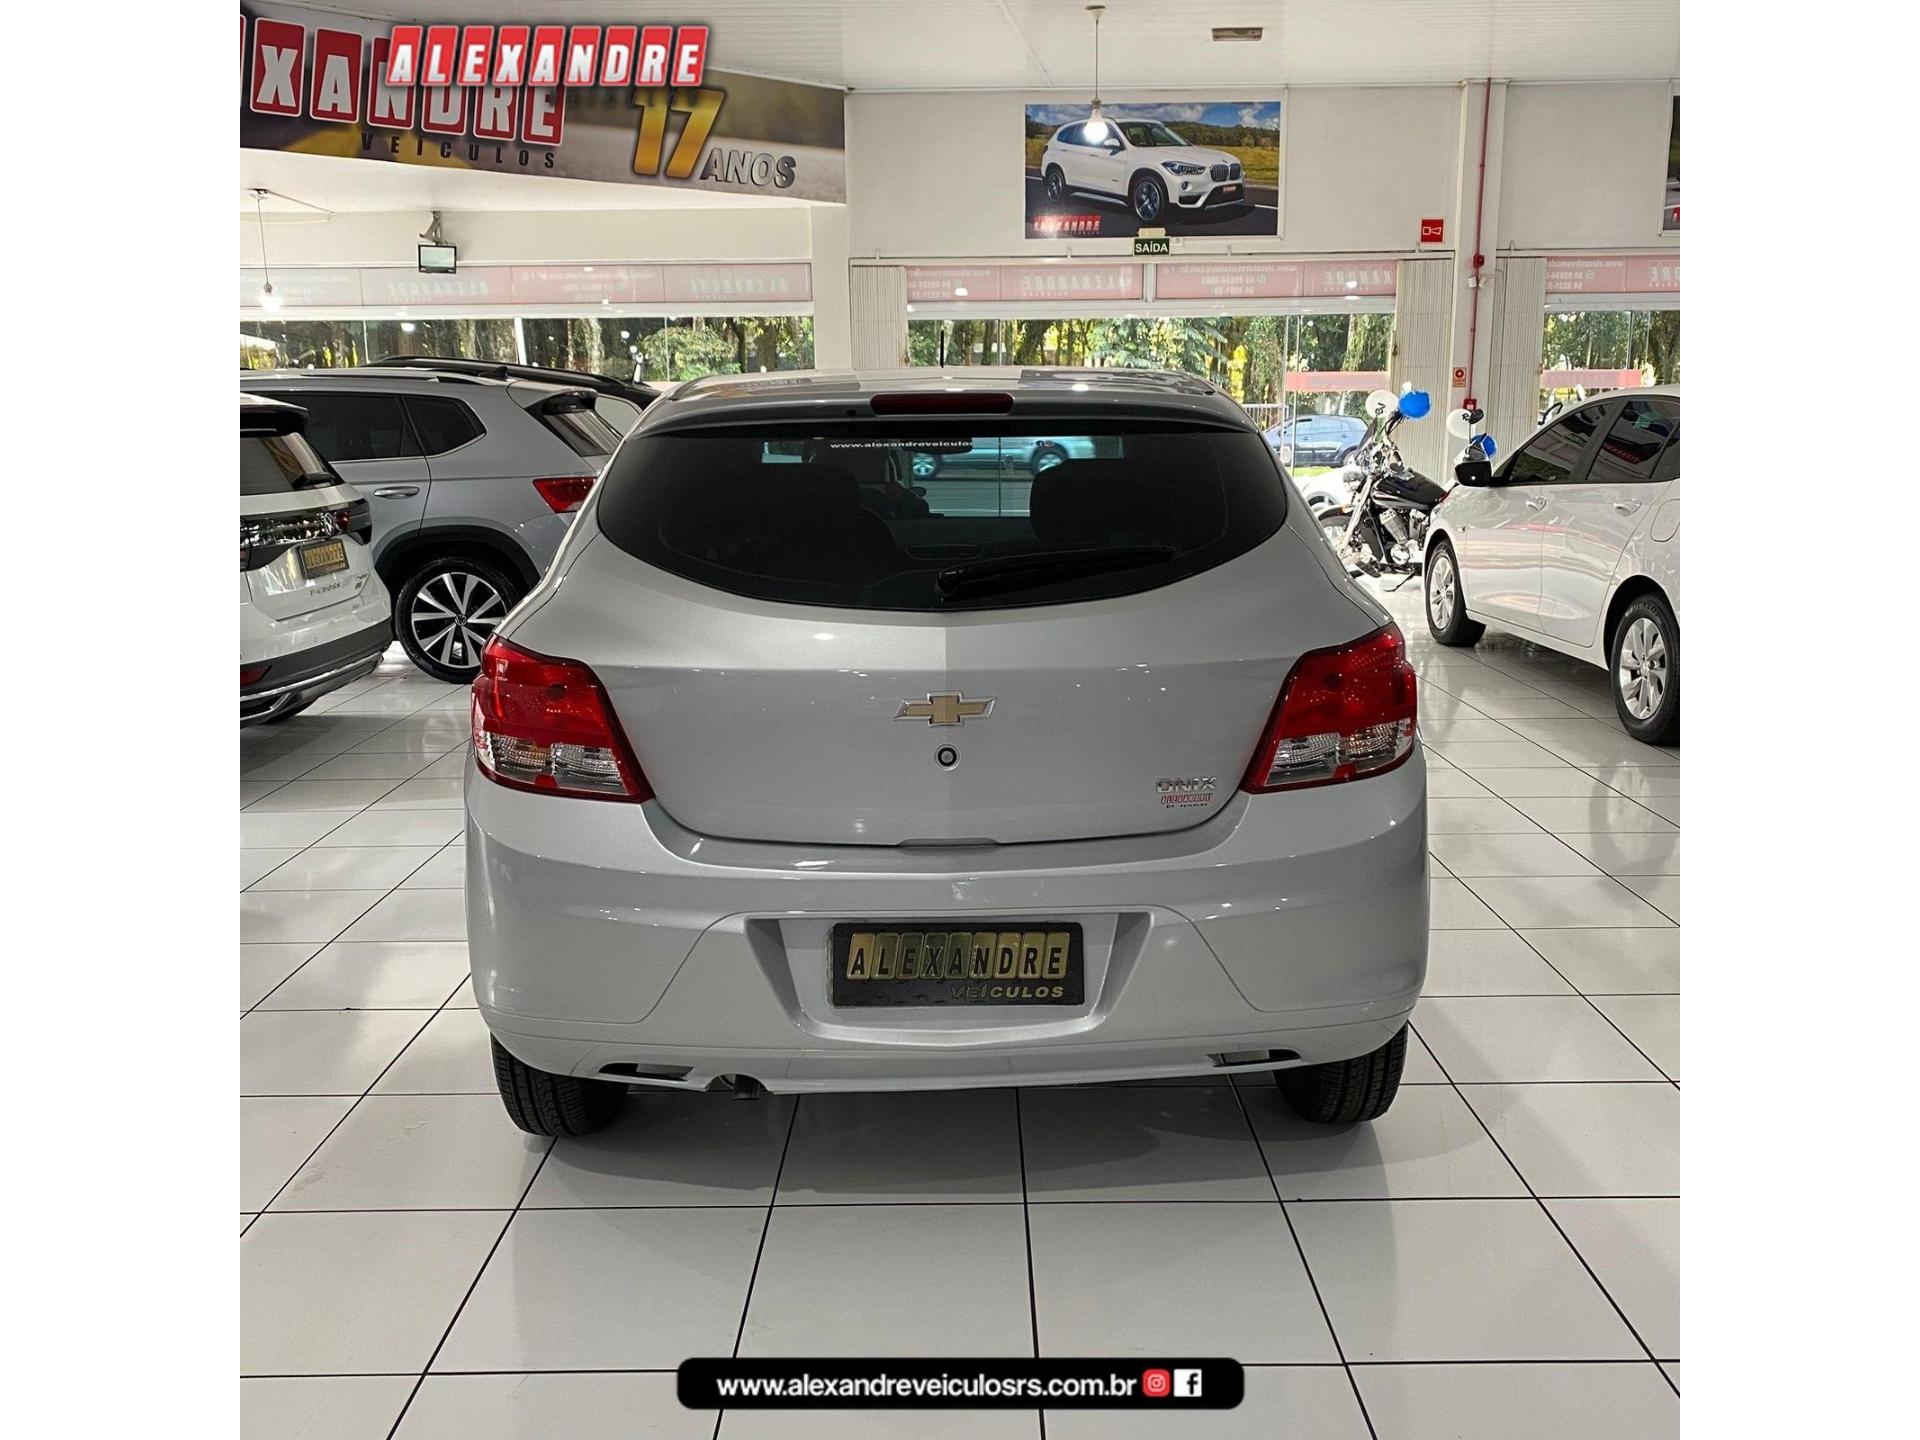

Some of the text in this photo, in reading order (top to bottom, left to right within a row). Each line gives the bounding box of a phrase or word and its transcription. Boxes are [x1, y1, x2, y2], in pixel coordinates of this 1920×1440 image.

[255, 44, 555, 137] XANDRE
[633, 88, 727, 178] 17
[699, 148, 796, 188] ANOS
[1135, 240, 1168, 253] SAÍDA
[1156, 777, 1216, 793] ONIX
[850, 946, 1063, 976] ALEXANDRE
